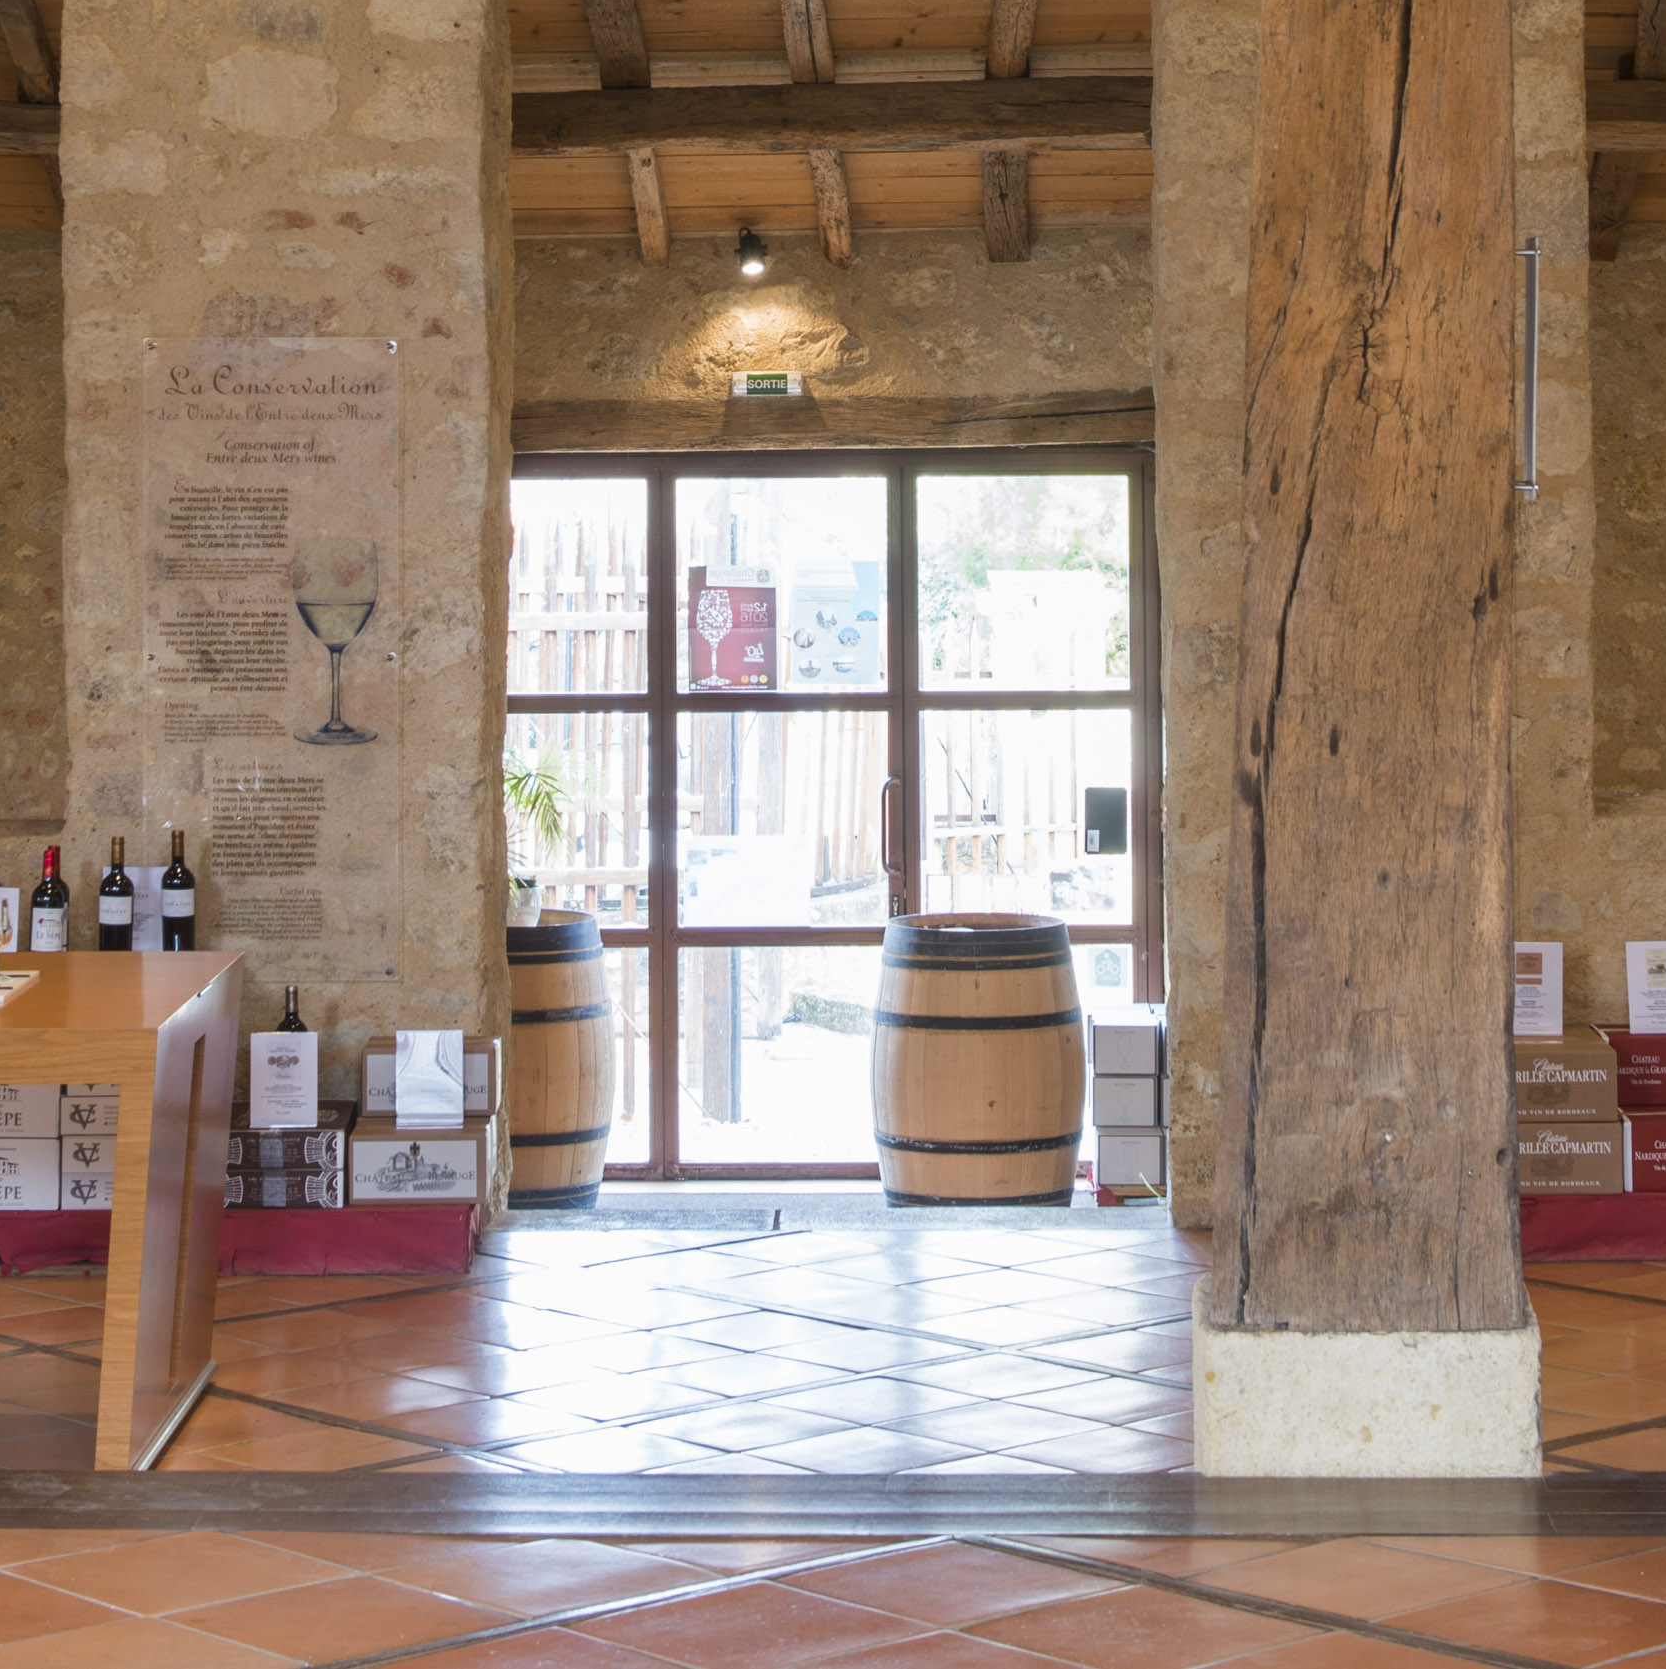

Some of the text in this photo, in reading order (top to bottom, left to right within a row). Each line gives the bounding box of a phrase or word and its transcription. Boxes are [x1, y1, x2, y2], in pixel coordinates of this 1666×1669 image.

[165, 364, 381, 395] La Conservation
[747, 379, 787, 389] SORTIE
[158, 403, 381, 421] des Vins de l'Entre deux Mers
[224, 438, 317, 453] Conservation of
[206, 452, 337, 464] Entre deux Mers wines
[1632, 1055, 1660, 1064] CHATEAU
[1515, 1070, 1607, 1082] RILLE CAPMARTIN
[1619, 1066, 1644, 1076] ARDIQUE
[1519, 1142, 1611, 1154] RILLE CAPMARTIN
[1635, 1151, 1666, 1162] NARDIQUE
